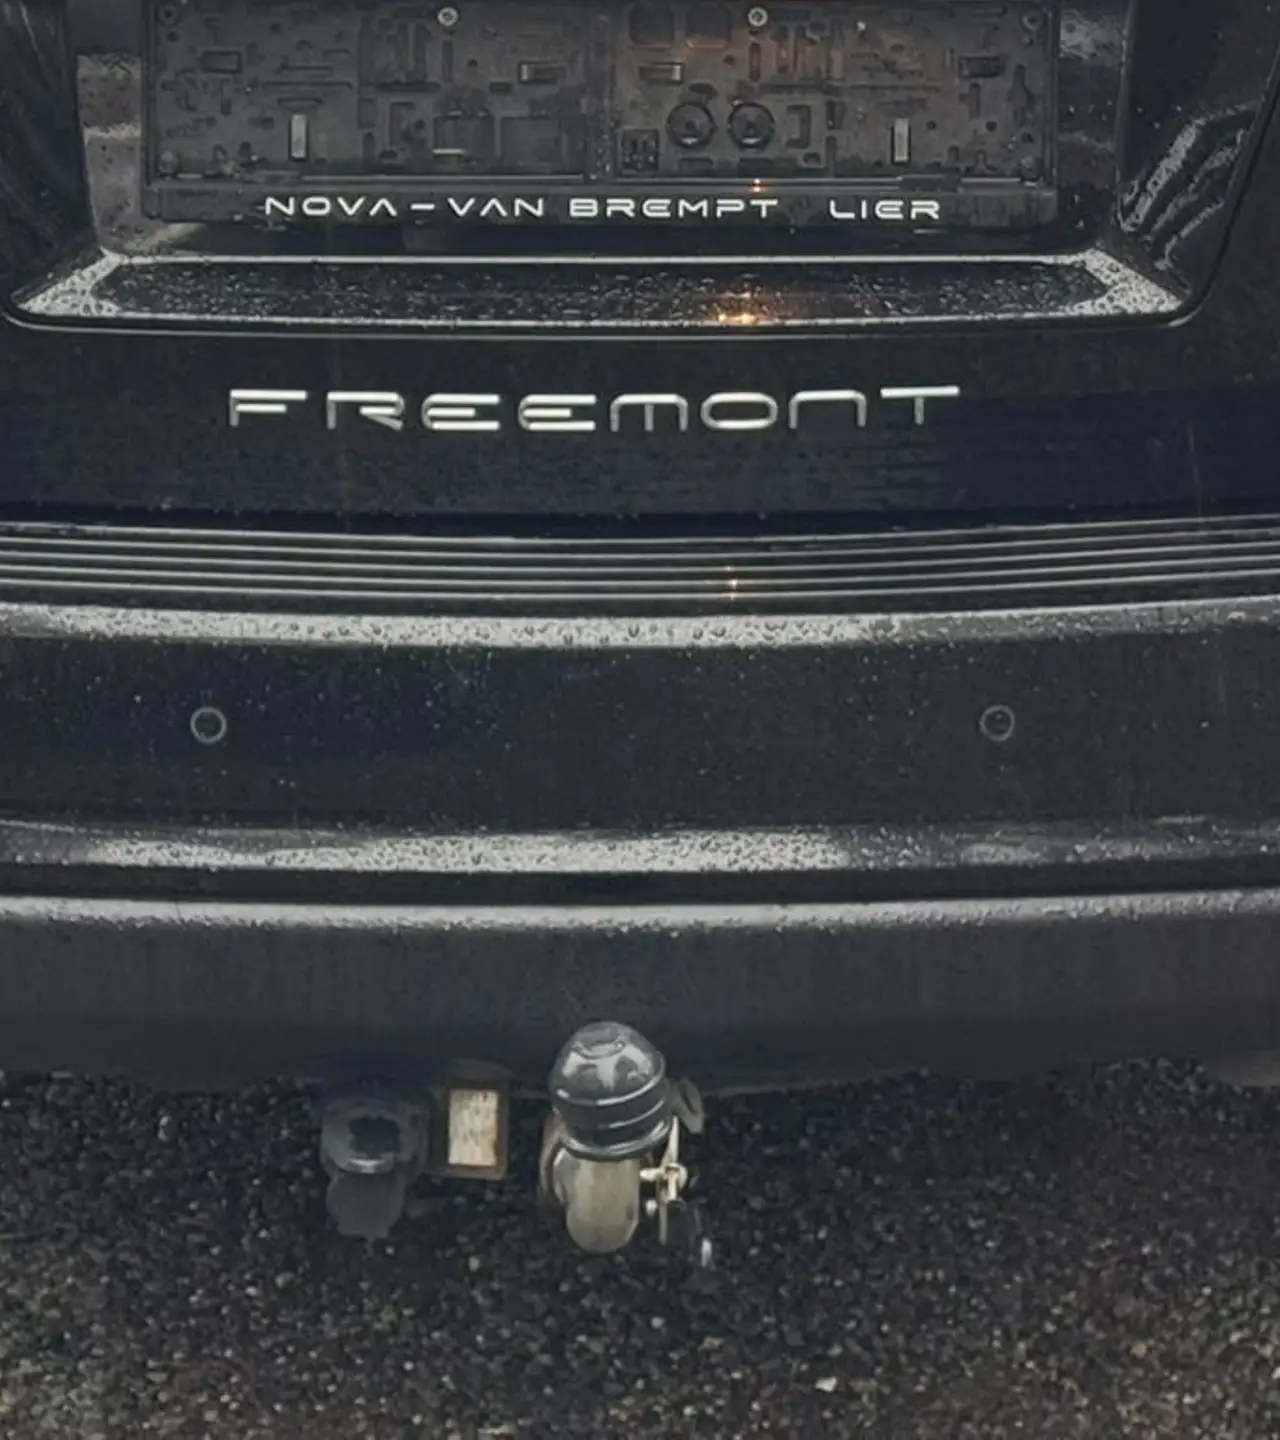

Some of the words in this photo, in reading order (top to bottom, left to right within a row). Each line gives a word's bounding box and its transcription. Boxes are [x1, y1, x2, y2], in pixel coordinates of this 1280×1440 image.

[568, 198, 778, 219] BREMPT
[829, 199, 940, 220] LIER
[229, 385, 960, 432] FREEMONT
